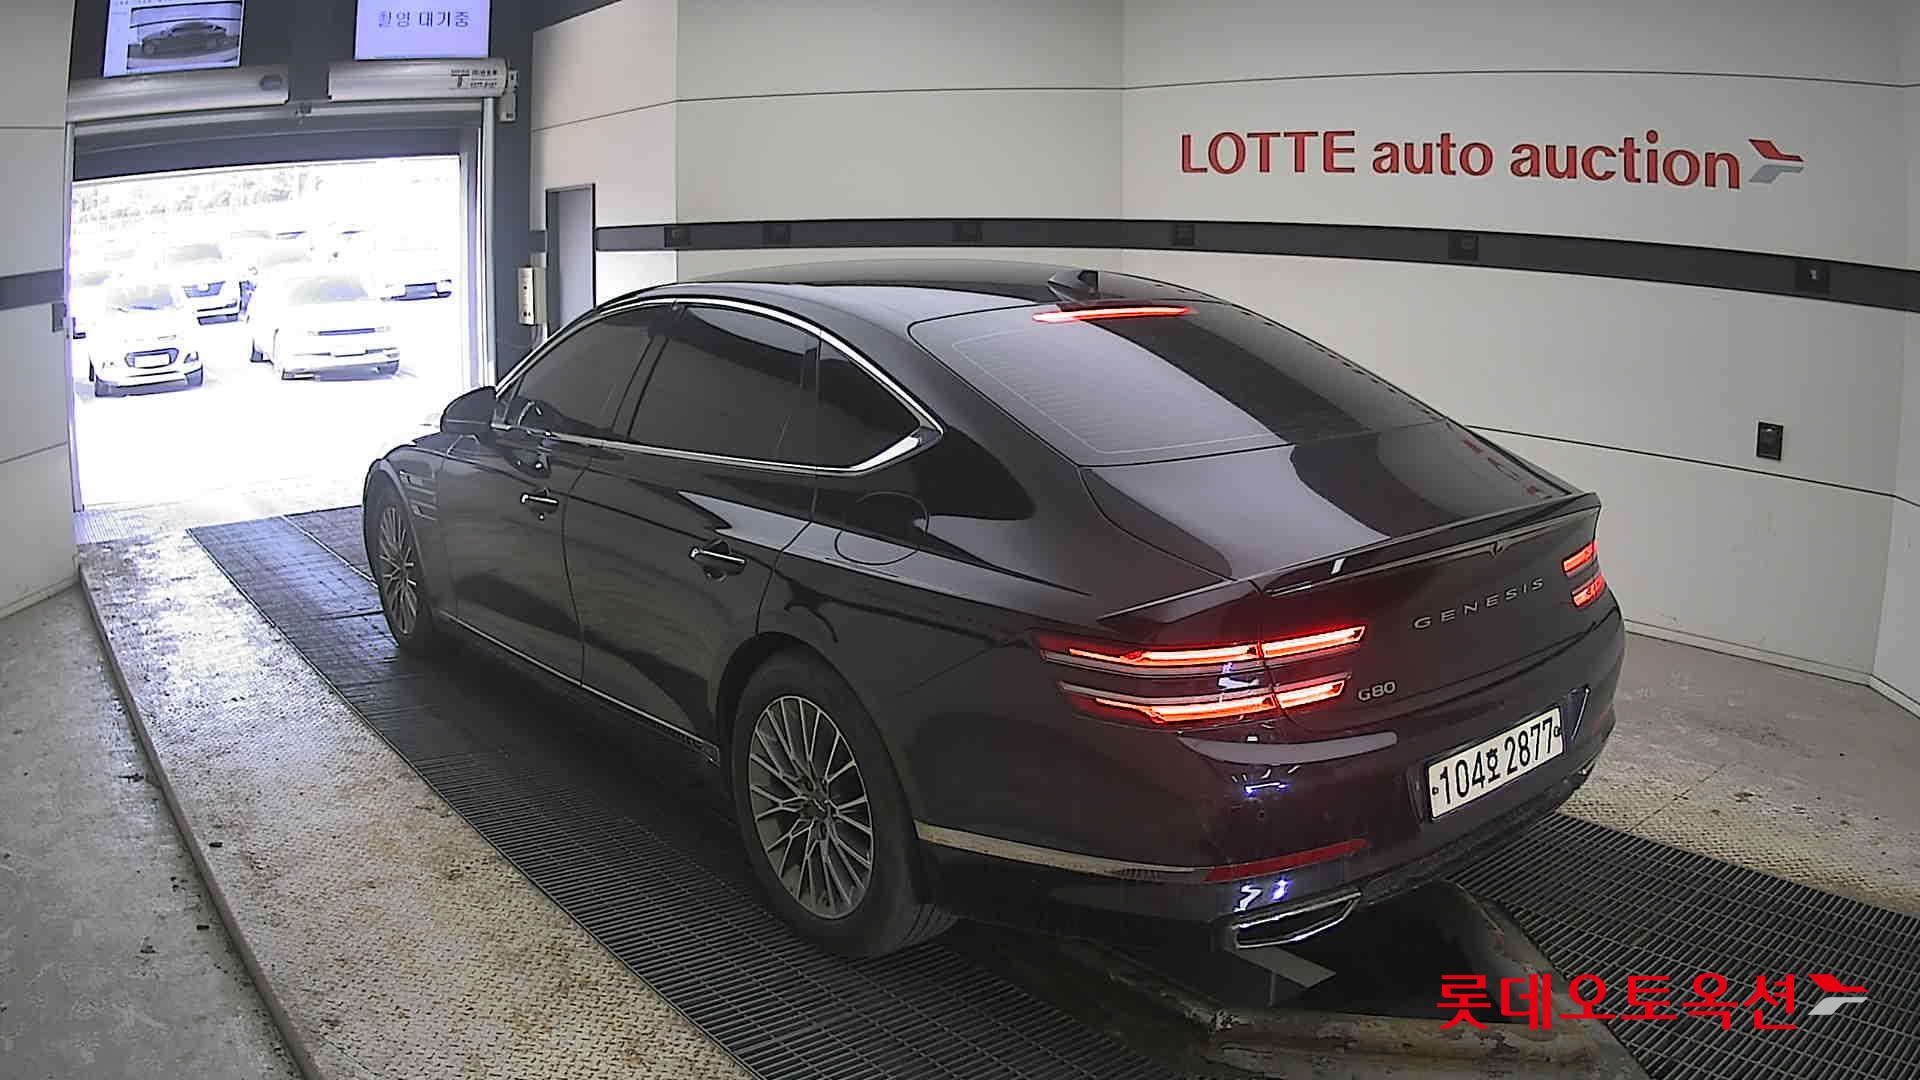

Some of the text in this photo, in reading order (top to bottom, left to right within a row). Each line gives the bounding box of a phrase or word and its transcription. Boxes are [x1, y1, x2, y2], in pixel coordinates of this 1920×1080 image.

[419, 11, 469, 27] 대기중
[1182, 130, 1740, 189] LOTTE auto auction
[1413, 577, 1544, 629] GENESIS
[1358, 681, 1397, 701] G80
[1504, 717, 1553, 775] 2877
